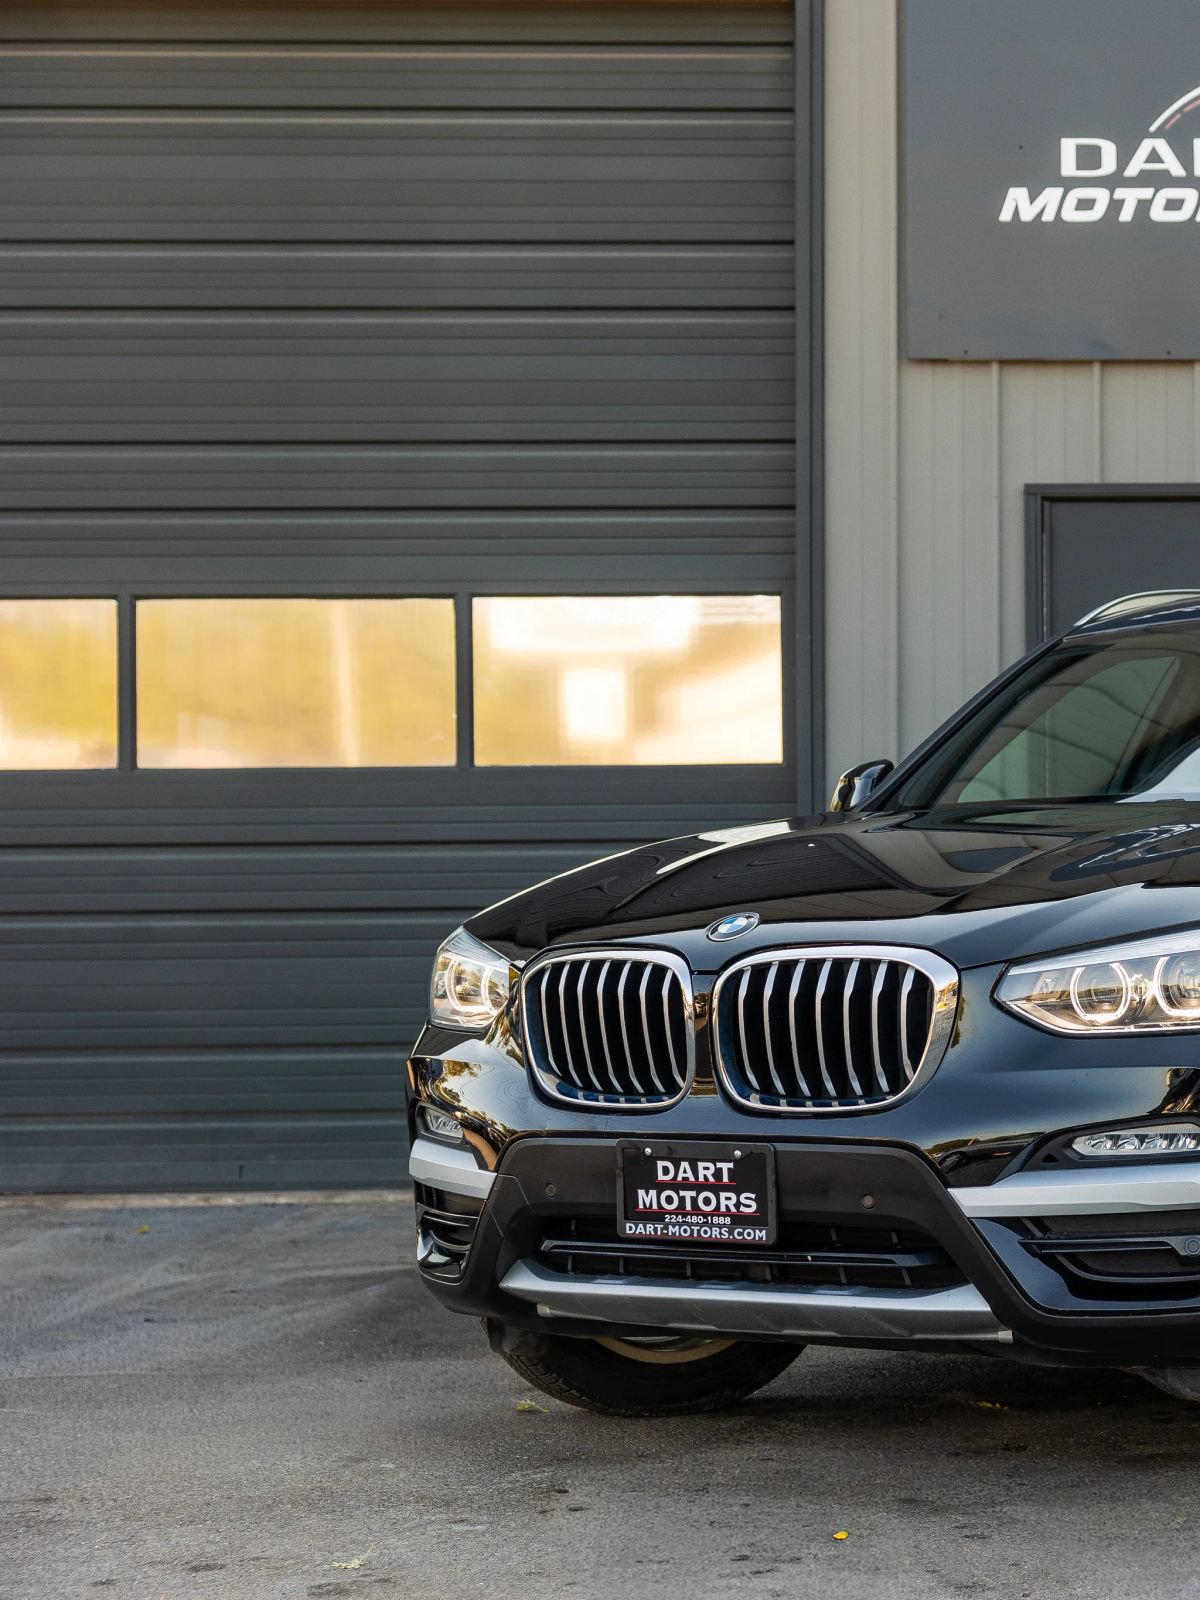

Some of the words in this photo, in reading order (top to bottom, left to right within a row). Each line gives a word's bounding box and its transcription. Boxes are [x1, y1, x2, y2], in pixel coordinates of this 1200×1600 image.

[656, 1160, 734, 1183] DART
[637, 1189, 757, 1213] MOTORS
[664, 1214, 731, 1225] 224-480-1888
[625, 1223, 767, 1241] DART-MOTORS.COM
